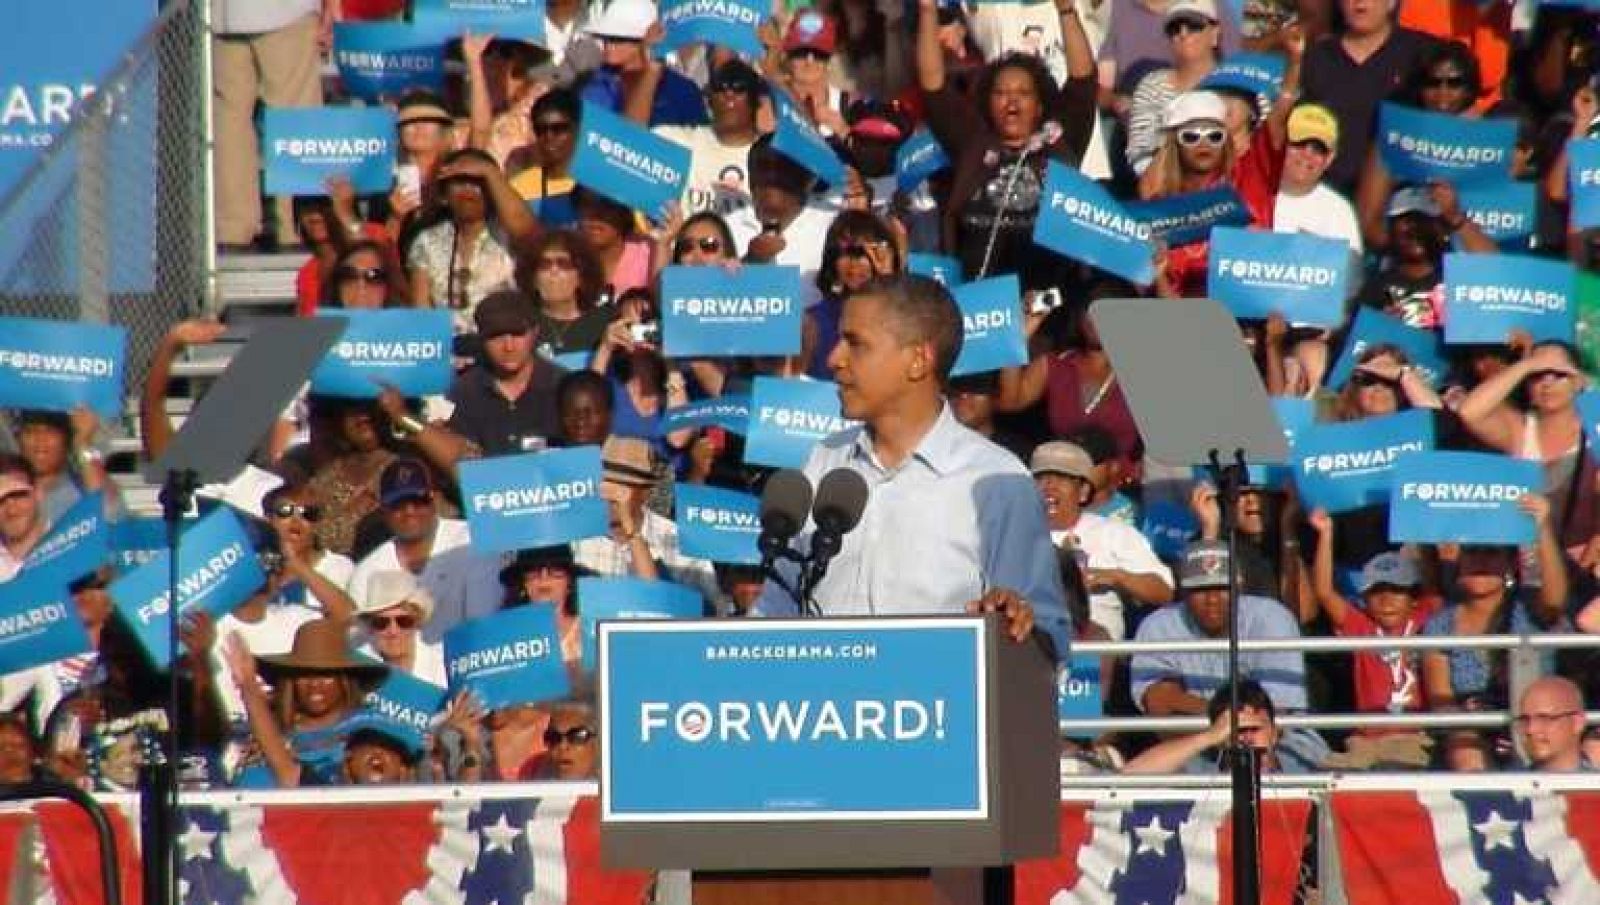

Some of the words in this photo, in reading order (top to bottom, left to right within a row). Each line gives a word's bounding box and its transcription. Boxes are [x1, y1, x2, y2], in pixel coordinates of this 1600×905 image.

[275, 137, 387, 156] FORWARD!
[587, 132, 682, 187] FORWARD!
[1386, 132, 1505, 163] FORWARD!
[1218, 259, 1337, 287] FORWARD!
[672, 297, 791, 316] FORWARD!
[1455, 285, 1567, 312] FORWARD!
[0, 351, 114, 377] FORWARD!
[474, 479, 595, 513] FORWARD!
[449, 637, 550, 676] FORWARD!
[705, 644, 877, 661] BARACKOBAMA.COM
[640, 700, 946, 742] FORWARD!
